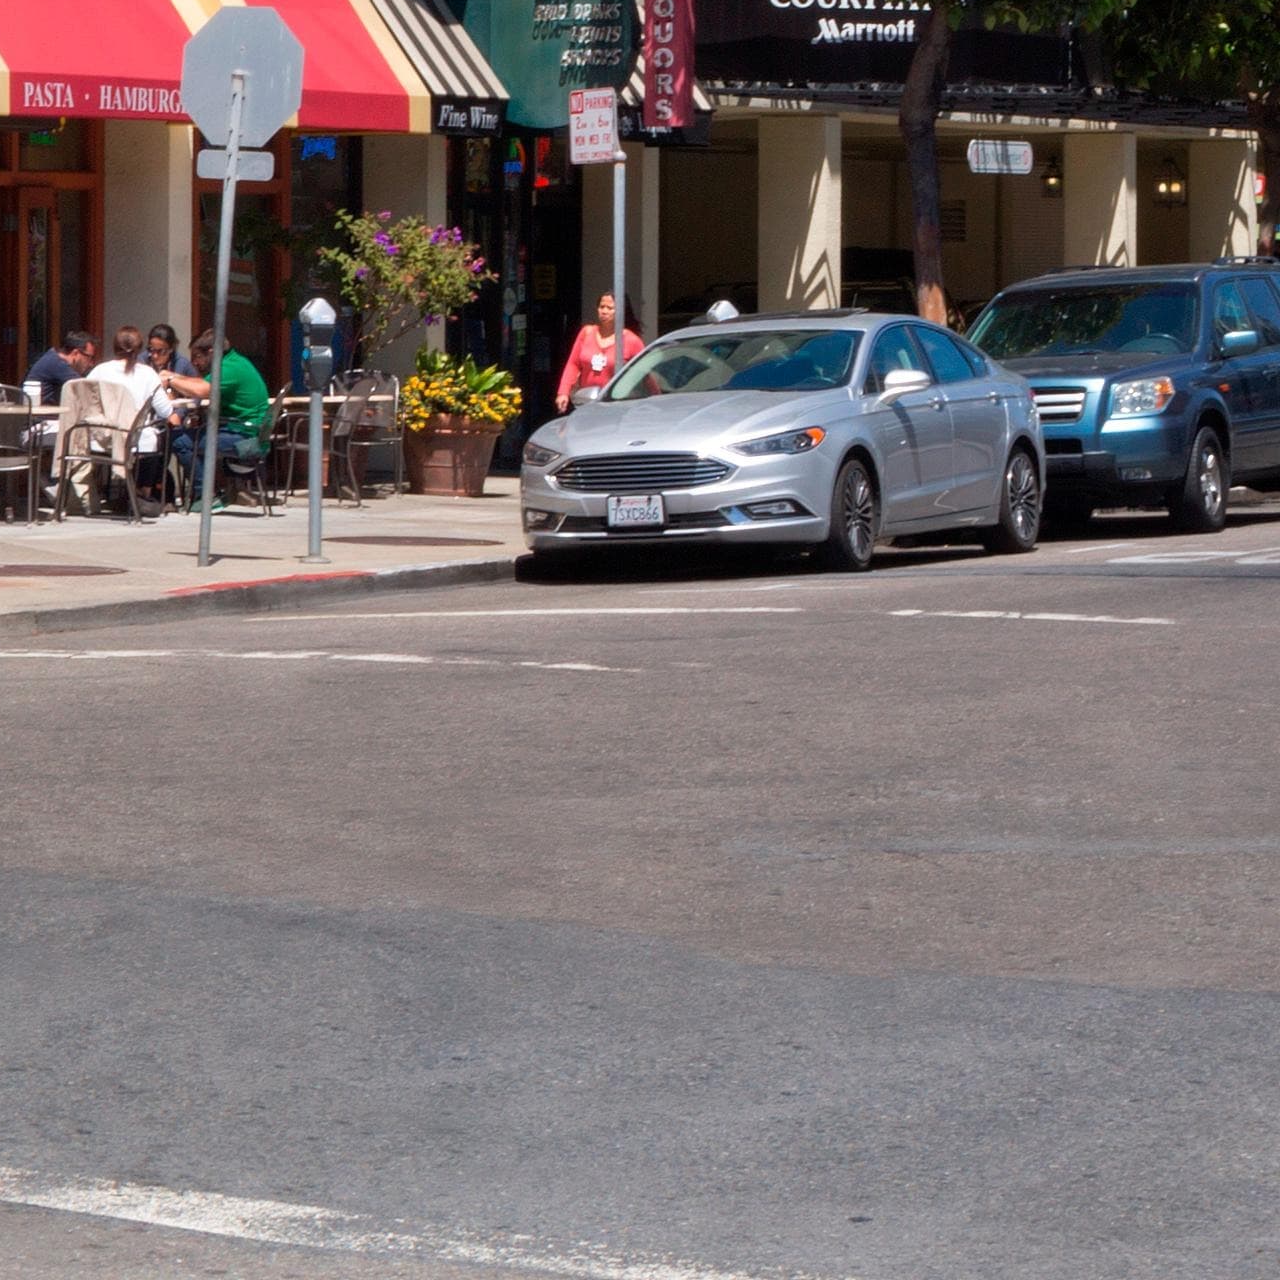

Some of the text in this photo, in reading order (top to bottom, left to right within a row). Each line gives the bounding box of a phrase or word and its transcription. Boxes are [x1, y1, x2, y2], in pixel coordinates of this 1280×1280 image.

[811, 18, 916, 44] Marriott
[23, 82, 186, 114] PASTA HAMBURG
[438, 104, 499, 130] Fine Wine
